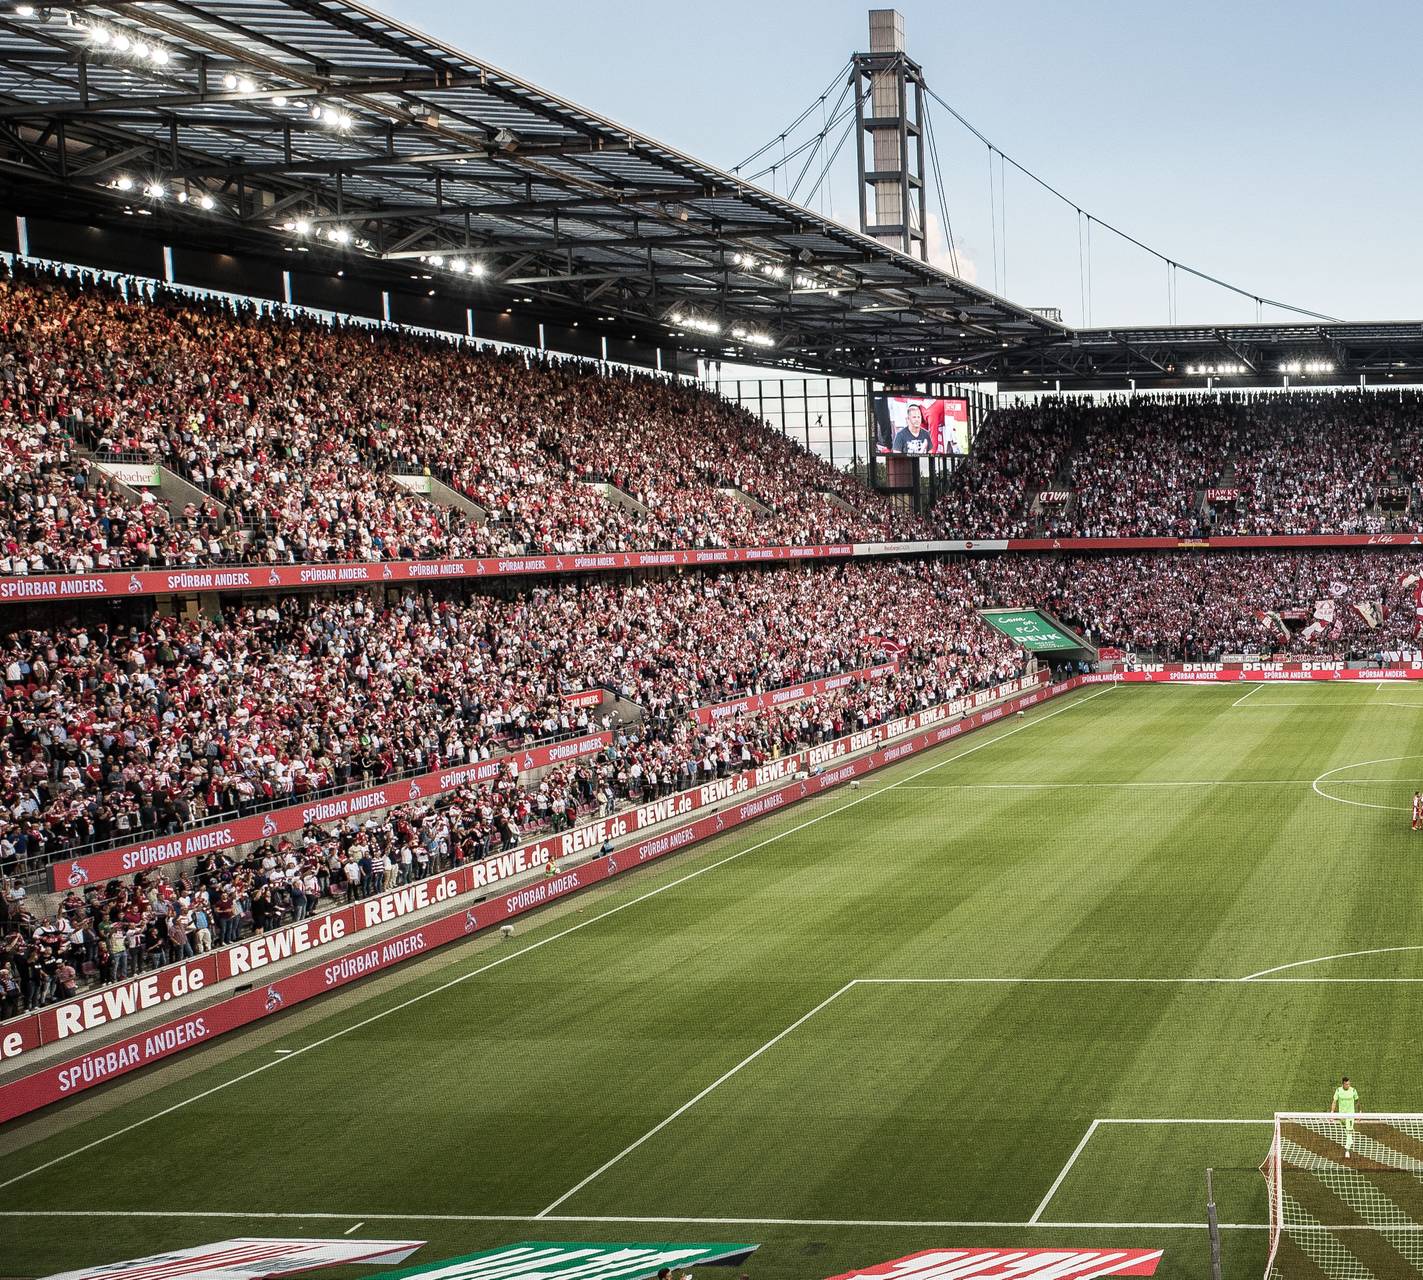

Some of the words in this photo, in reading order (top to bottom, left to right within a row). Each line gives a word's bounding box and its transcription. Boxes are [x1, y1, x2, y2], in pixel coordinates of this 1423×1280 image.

[1207, 489, 1239, 499] HAWKS
[168, 573, 212, 589] SPÜRBAR
[215, 573, 252, 586] ANDERS.
[300, 567, 337, 582] SPÜRBAR
[339, 567, 369, 580] ANDERS.
[409, 564, 441, 576] SPÜRBAR
[443, 563, 466, 574] ANDERS.
[498, 560, 524, 572] SPÜRBAR
[525, 560, 547, 570] ANDERS.
[1, 579, 57, 597] SPÜRBAR
[60, 579, 107, 594] ANDERS.
[1013, 633, 1062, 642] DEVK
[550, 743, 578, 761] SPÜRBAR
[579, 737, 604, 753] ANDERS.
[809, 740, 846, 767] REWE.de
[755, 757, 797, 786] REWE.de
[700, 774, 749, 806] REWE.de
[303, 800, 348, 823] SPÜRBAR
[350, 791, 388, 812] ANDERS.
[637, 794, 692, 829] REWE.de
[123, 840, 182, 869] SPÜRBAR
[186, 828, 235, 853] ANDERS.
[562, 818, 627, 856] REWE.de
[639, 839, 669, 860] SPÜRBAR
[670, 828, 696, 847] ANDERS.
[472, 844, 550, 889] REWE.de
[365, 877, 457, 928] REWE.de
[507, 886, 546, 913] SPÜRBAR
[548, 872, 581, 897] ANDERS.
[229, 915, 345, 976] REWE.de
[325, 952, 379, 985] SPÜRBAR
[383, 933, 427, 963] ANDERS.
[56, 965, 204, 1039] REWE.de
[58, 1043, 141, 1091] SPÜRBAR
[145, 1017, 210, 1058] ANDERS.
